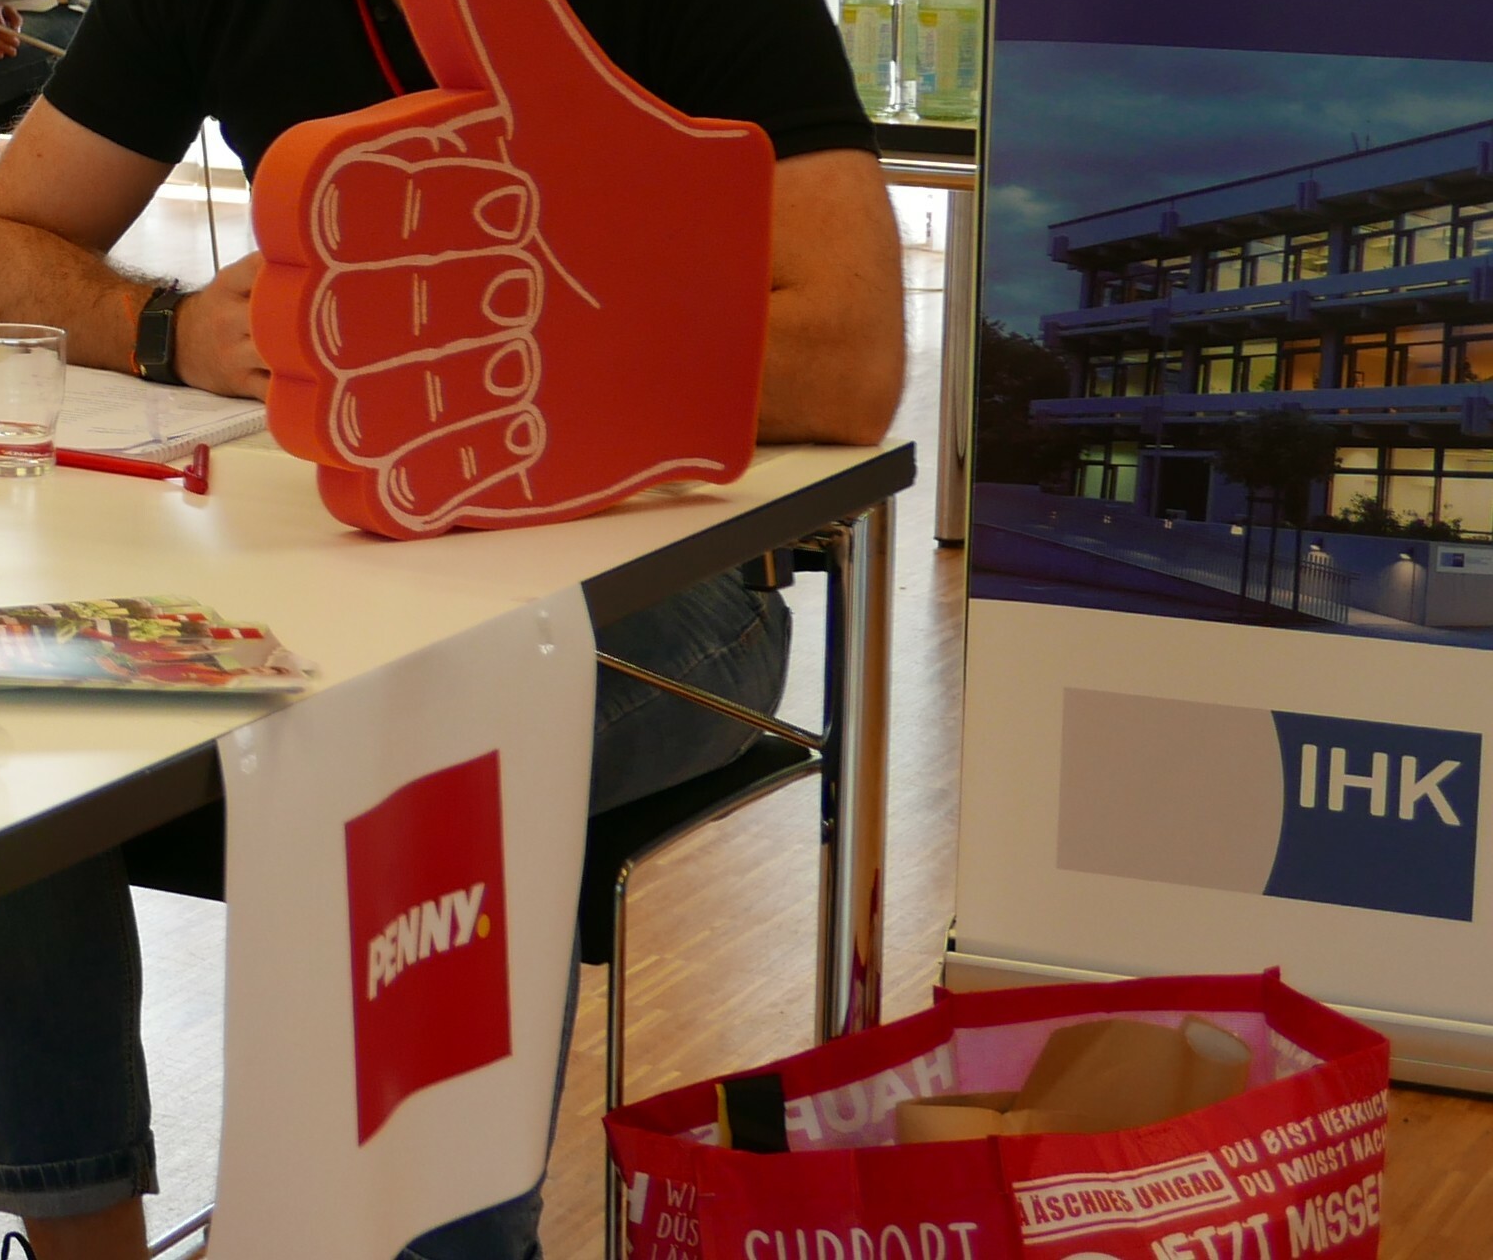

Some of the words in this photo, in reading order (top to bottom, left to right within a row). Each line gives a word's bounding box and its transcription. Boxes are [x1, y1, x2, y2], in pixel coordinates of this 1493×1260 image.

[1299, 744, 1461, 827] IHK
[1220, 1138, 1258, 1168] DU
[1260, 1116, 1318, 1156] BIST
[1237, 1169, 1275, 1198] DU
[1277, 1141, 1348, 1186] MUSST
